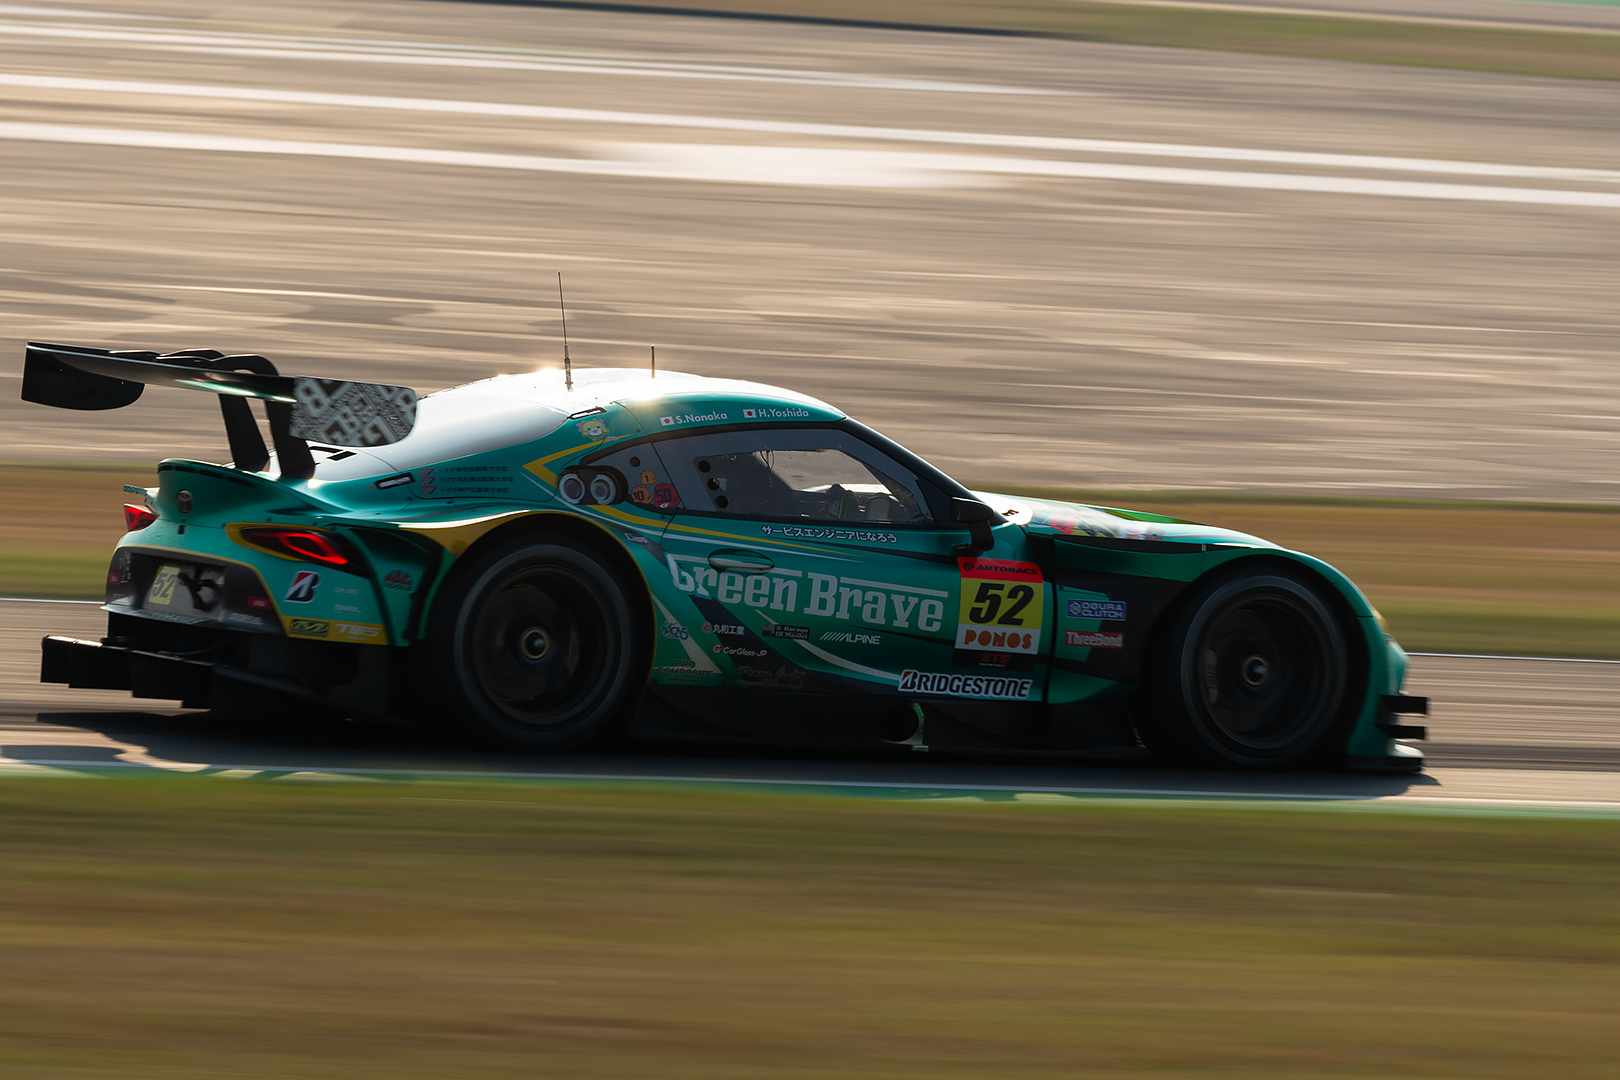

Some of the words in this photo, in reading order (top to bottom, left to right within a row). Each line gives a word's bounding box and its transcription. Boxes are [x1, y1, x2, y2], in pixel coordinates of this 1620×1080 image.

[675, 411, 728, 424] S.Nonaka
[758, 408, 810, 418] H.Yoshida
[645, 475, 649, 483] 1
[632, 490, 644, 501] 10
[656, 488, 672, 503] 50
[761, 525, 898, 543] サービスエンジニアになろう
[976, 564, 1038, 577] AUTOBACS
[151, 572, 177, 599] 52
[665, 553, 802, 612] Green
[803, 571, 949, 632] Brave
[968, 582, 1035, 627] 52
[1081, 602, 1124, 612] OGURA
[1081, 609, 1125, 620] CLUTCH
[712, 623, 745, 637] 丸和工業
[838, 633, 881, 646] ALPINE
[963, 629, 1033, 650] PONOS
[1066, 631, 1123, 647] ThreeBond
[675, 659, 697, 669] PRO
[655, 666, 714, 679] COMPOSITE
[900, 671, 1033, 698] BRIDGESTONE
